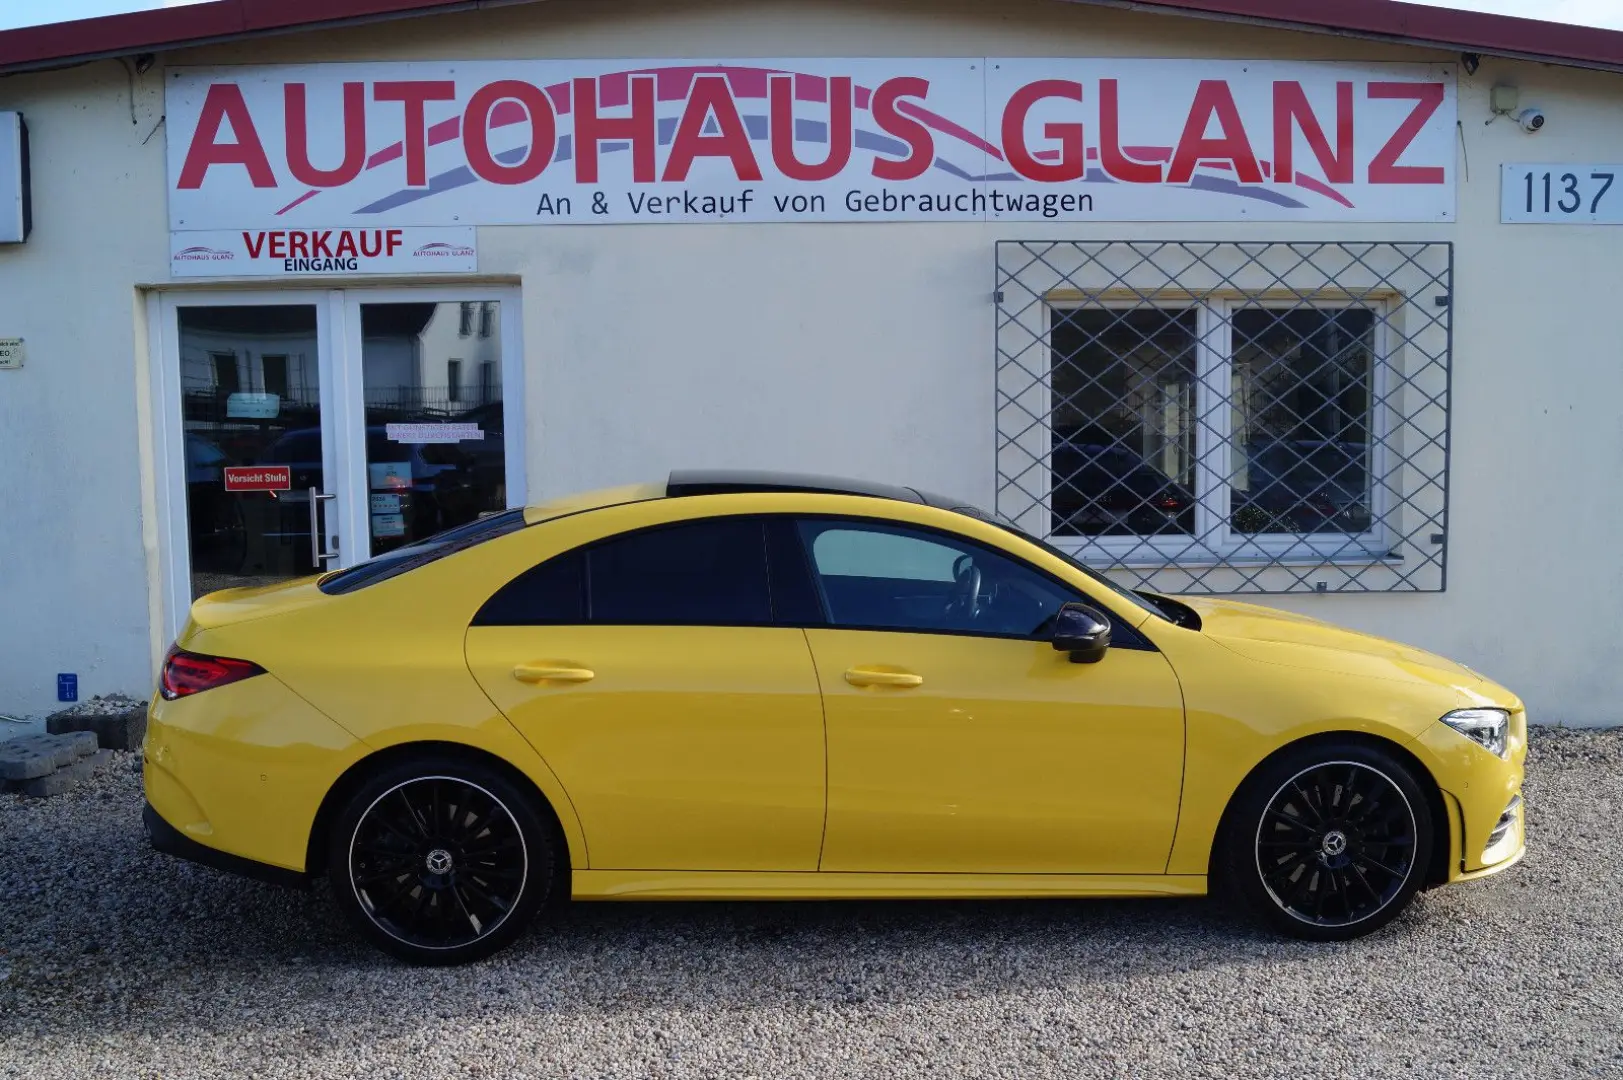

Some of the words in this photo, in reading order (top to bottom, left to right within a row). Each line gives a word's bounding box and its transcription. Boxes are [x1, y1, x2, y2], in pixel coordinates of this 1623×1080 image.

[176, 74, 935, 189] AUTOHAUS
[1001, 78, 1446, 184] GLANZ
[536, 193, 571, 215] An
[591, 191, 609, 214] &
[627, 190, 754, 214] Verkauf
[774, 194, 825, 213] von
[845, 188, 1093, 218] Gebrauchtwagen
[1524, 172, 1614, 213] 1137
[242, 230, 403, 259] VERKAUF
[452, 249, 475, 257] GLANZ
[284, 258, 358, 272] EINGANG
[228, 473, 263, 483] Vorsicht
[264, 473, 287, 482] Stufe
